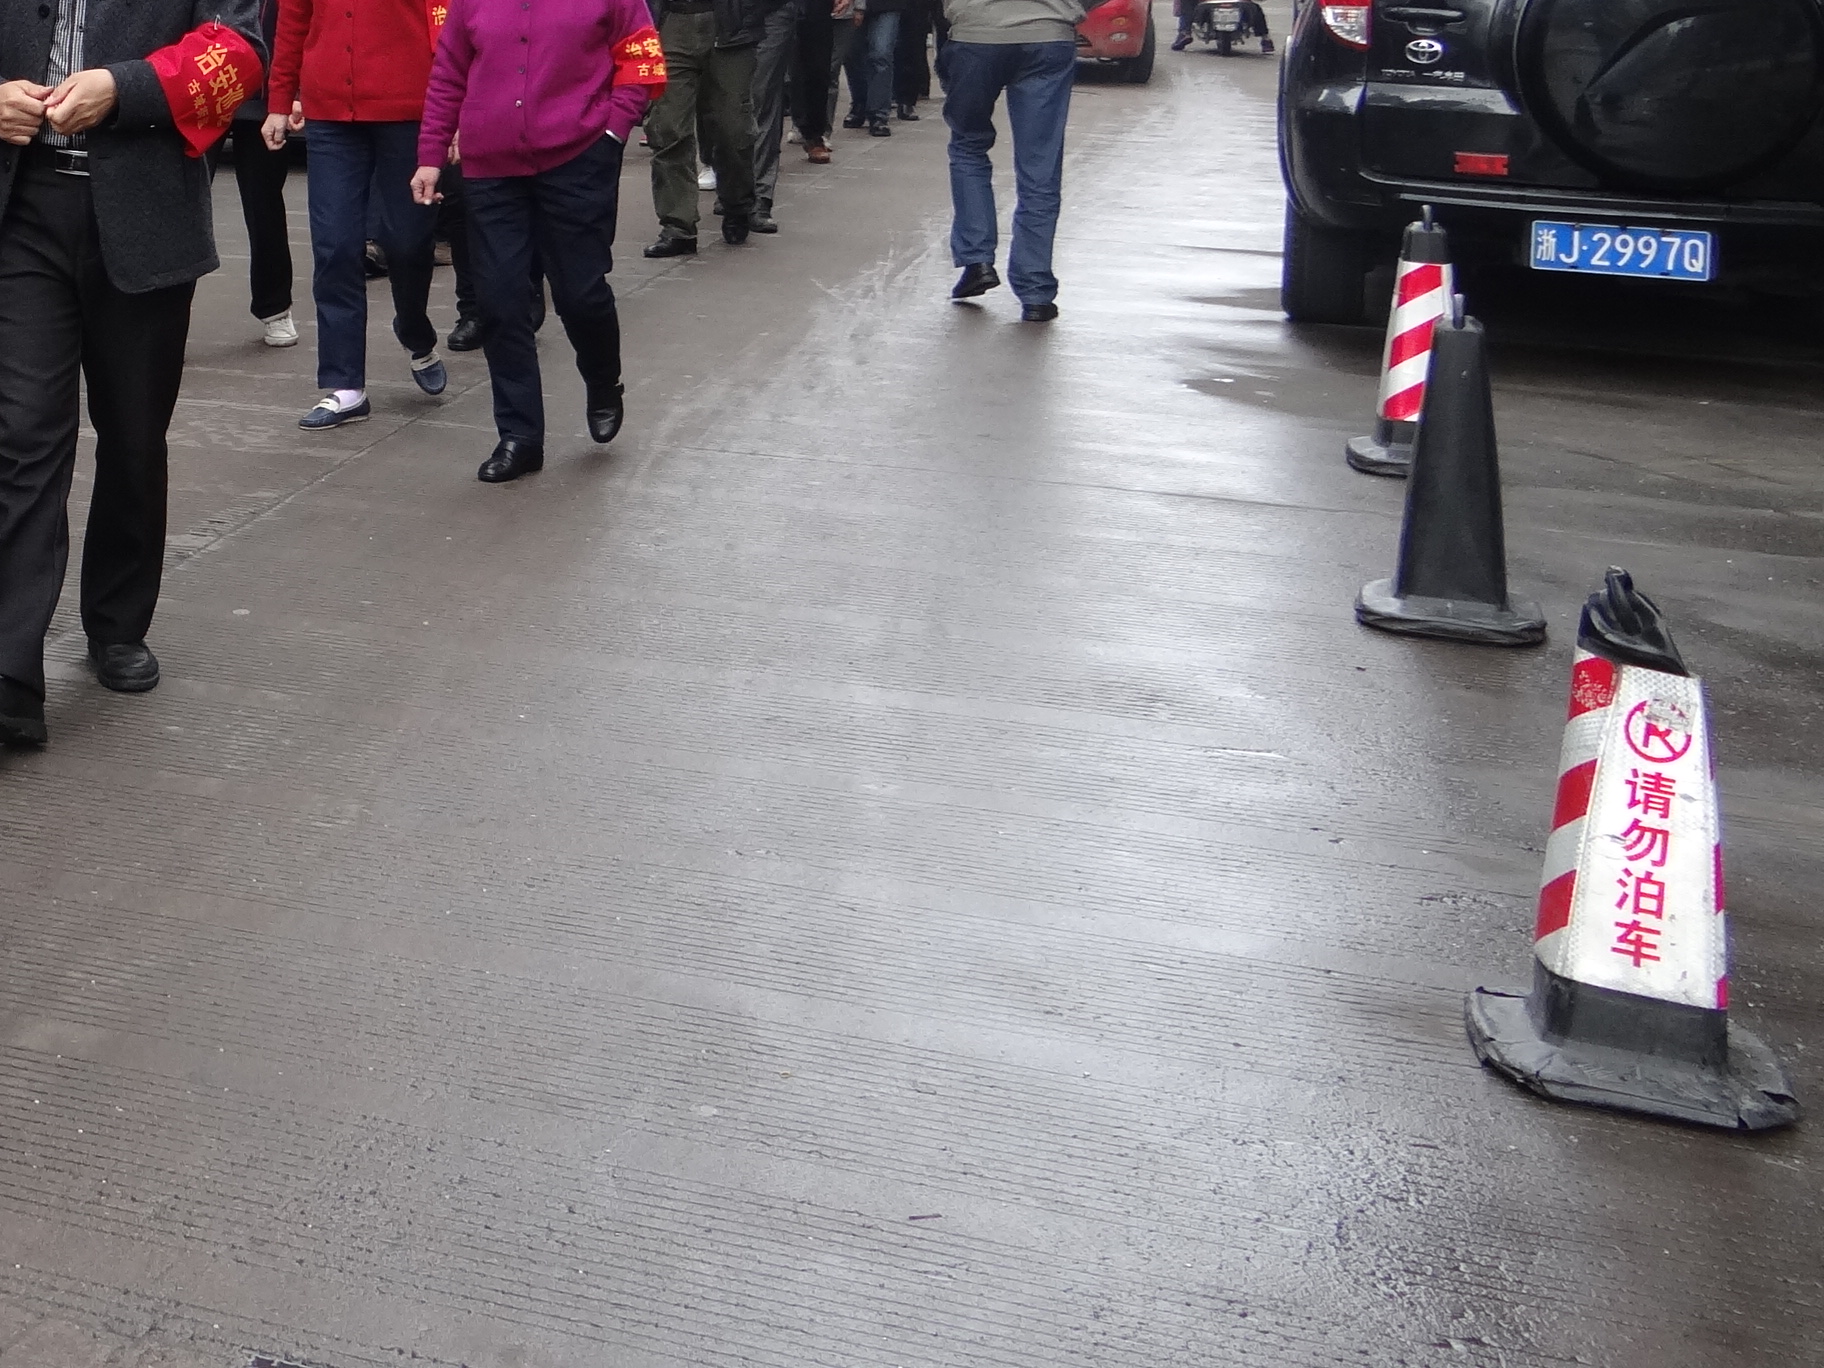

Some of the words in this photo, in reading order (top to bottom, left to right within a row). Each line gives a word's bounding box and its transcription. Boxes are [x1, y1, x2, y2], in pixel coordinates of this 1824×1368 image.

[626, 37, 663, 59] 治安
[638, 63, 665, 77] 古城
[1611, 768, 1676, 968] 请勿泊车
